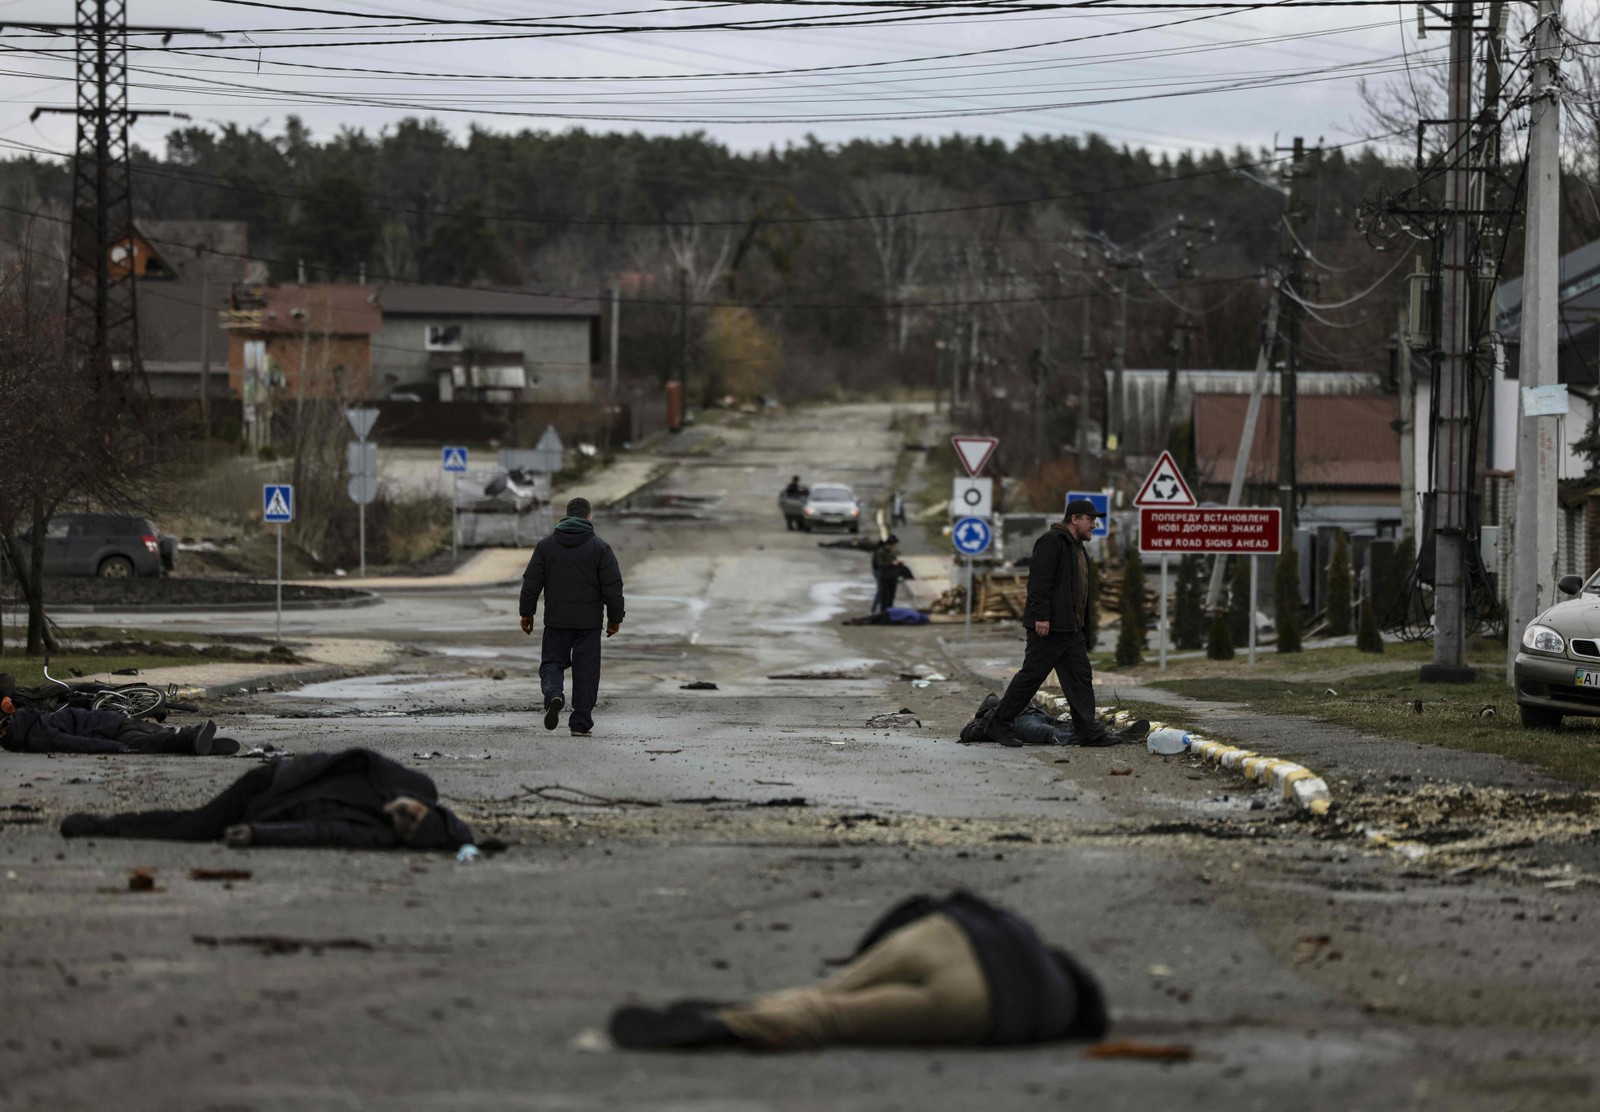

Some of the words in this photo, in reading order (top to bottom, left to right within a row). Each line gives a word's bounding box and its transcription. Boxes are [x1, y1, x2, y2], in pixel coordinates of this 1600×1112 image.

[1151, 513, 1200, 523] ПОПЕРЕДУ
[1204, 513, 1269, 523] ВСТАНОВЛЕНІ
[1157, 524, 1179, 532] НОВІ
[1182, 524, 1228, 533] ДОРОЖНІ
[1231, 525, 1263, 533] ЗНАКИ
[1151, 538, 1172, 547] NEW
[1175, 538, 1202, 547] ROAD
[1205, 538, 1233, 548] SIGNS
[1236, 539, 1269, 548] AHEAD
[1583, 673, 1598, 686] AI
